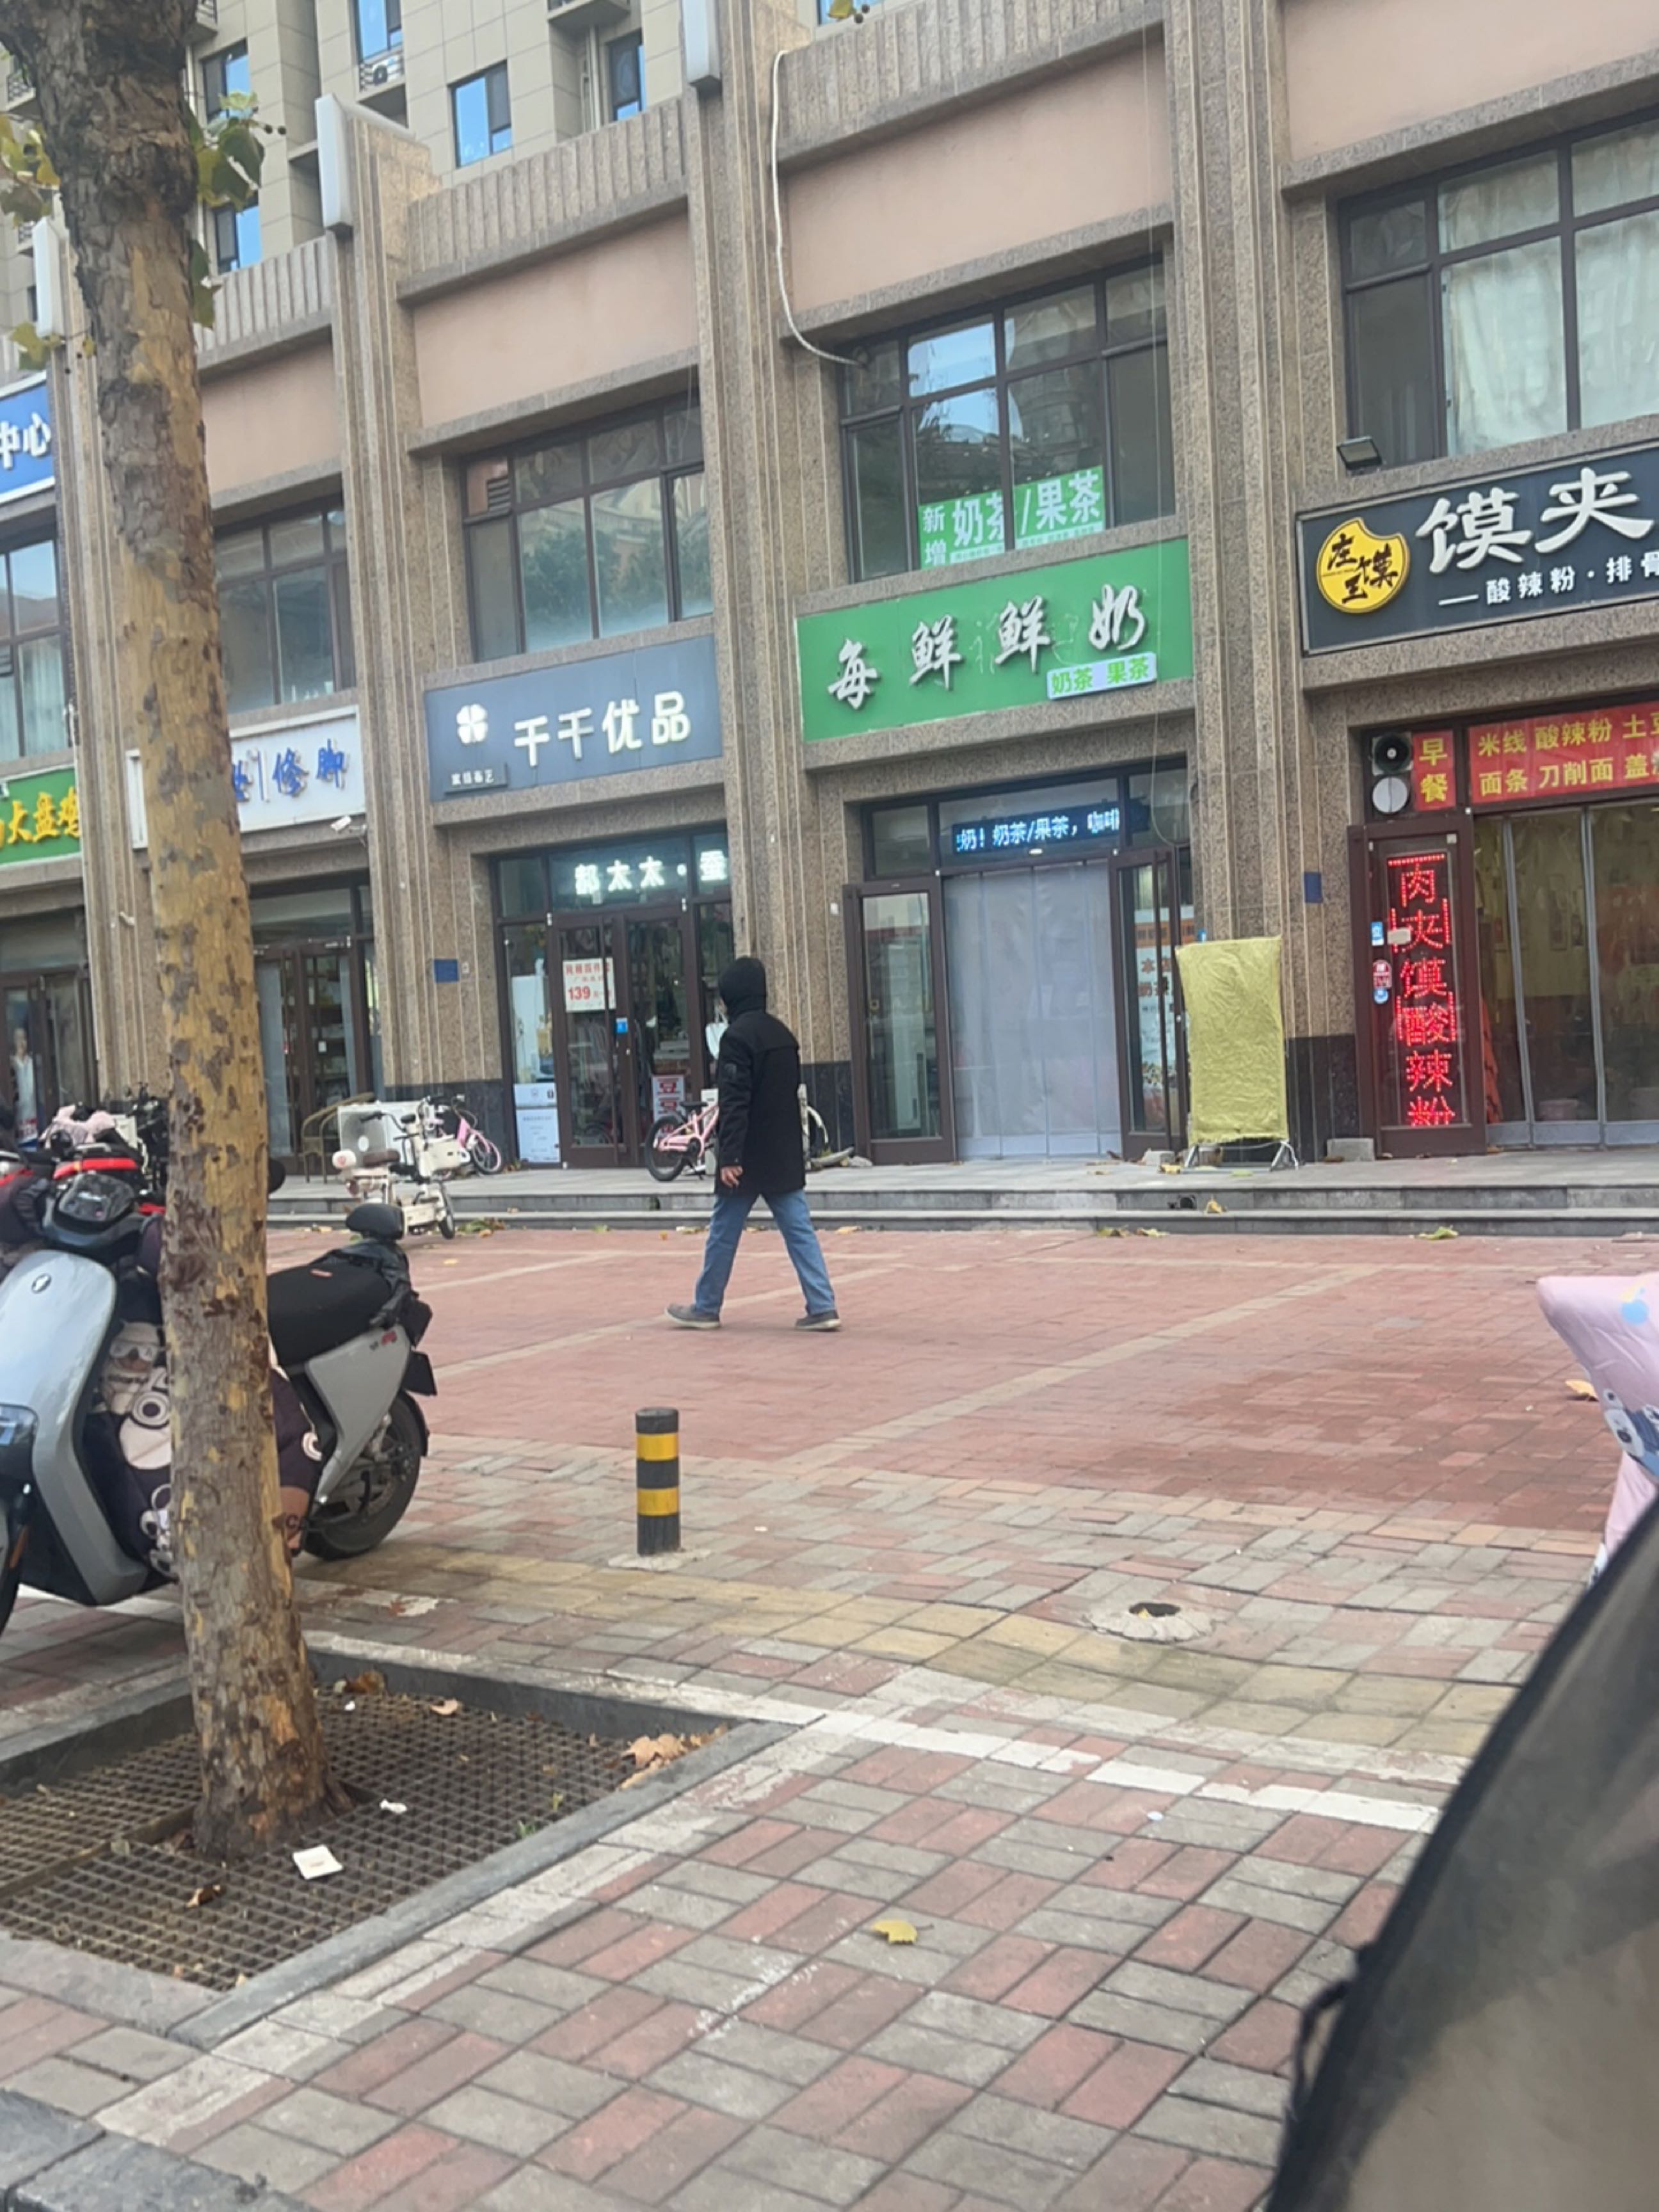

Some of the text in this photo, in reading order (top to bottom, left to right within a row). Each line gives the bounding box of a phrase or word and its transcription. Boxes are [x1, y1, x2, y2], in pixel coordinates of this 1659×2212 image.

[0, 412, 51, 470] 中心
[922, 505, 947, 566] 新增
[1415, 467, 1655, 574] 馍夹
[827, 583, 1147, 709] 每鲜鲜奶
[1052, 655, 1149, 693] 奶茶 果茶
[514, 691, 691, 767] 千千优品
[1479, 728, 1527, 757] 米线
[1535, 717, 1612, 750] 酸辣粉
[272, 739, 346, 794] 修脚
[1419, 738, 1448, 803] 早餐
[1479, 769, 1528, 797] 面条
[1539, 757, 1613, 789] 刀削面
[568, 986, 591, 1000] 139
